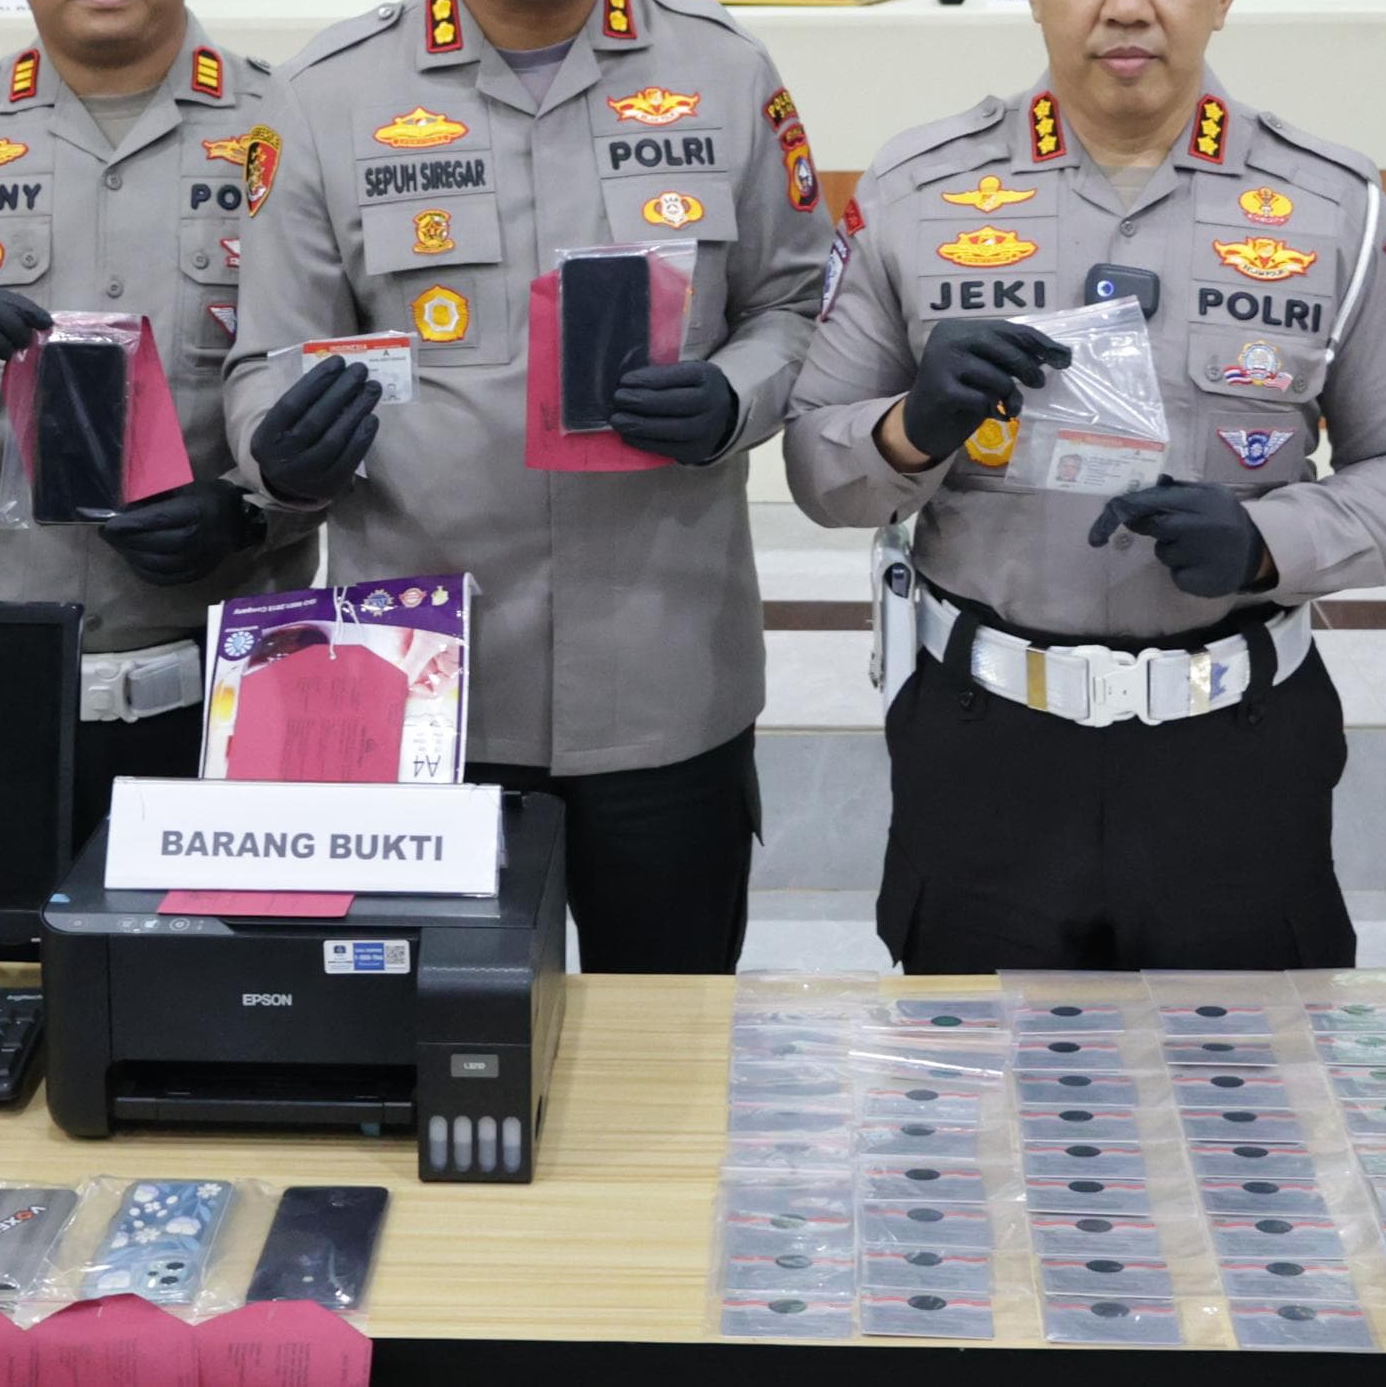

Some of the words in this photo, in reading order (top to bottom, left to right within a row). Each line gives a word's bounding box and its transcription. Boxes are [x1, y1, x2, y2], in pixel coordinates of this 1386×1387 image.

[609, 137, 715, 171] POLRI
[364, 164, 418, 198] SEPUH
[420, 159, 487, 192] SIREGAR
[930, 279, 1046, 310] JEKI
[1198, 287, 1323, 333] POLRI
[413, 754, 442, 778] A4
[161, 830, 316, 861] BARANG
[329, 833, 444, 861] BUKTI
[242, 993, 293, 1007] EPSON
